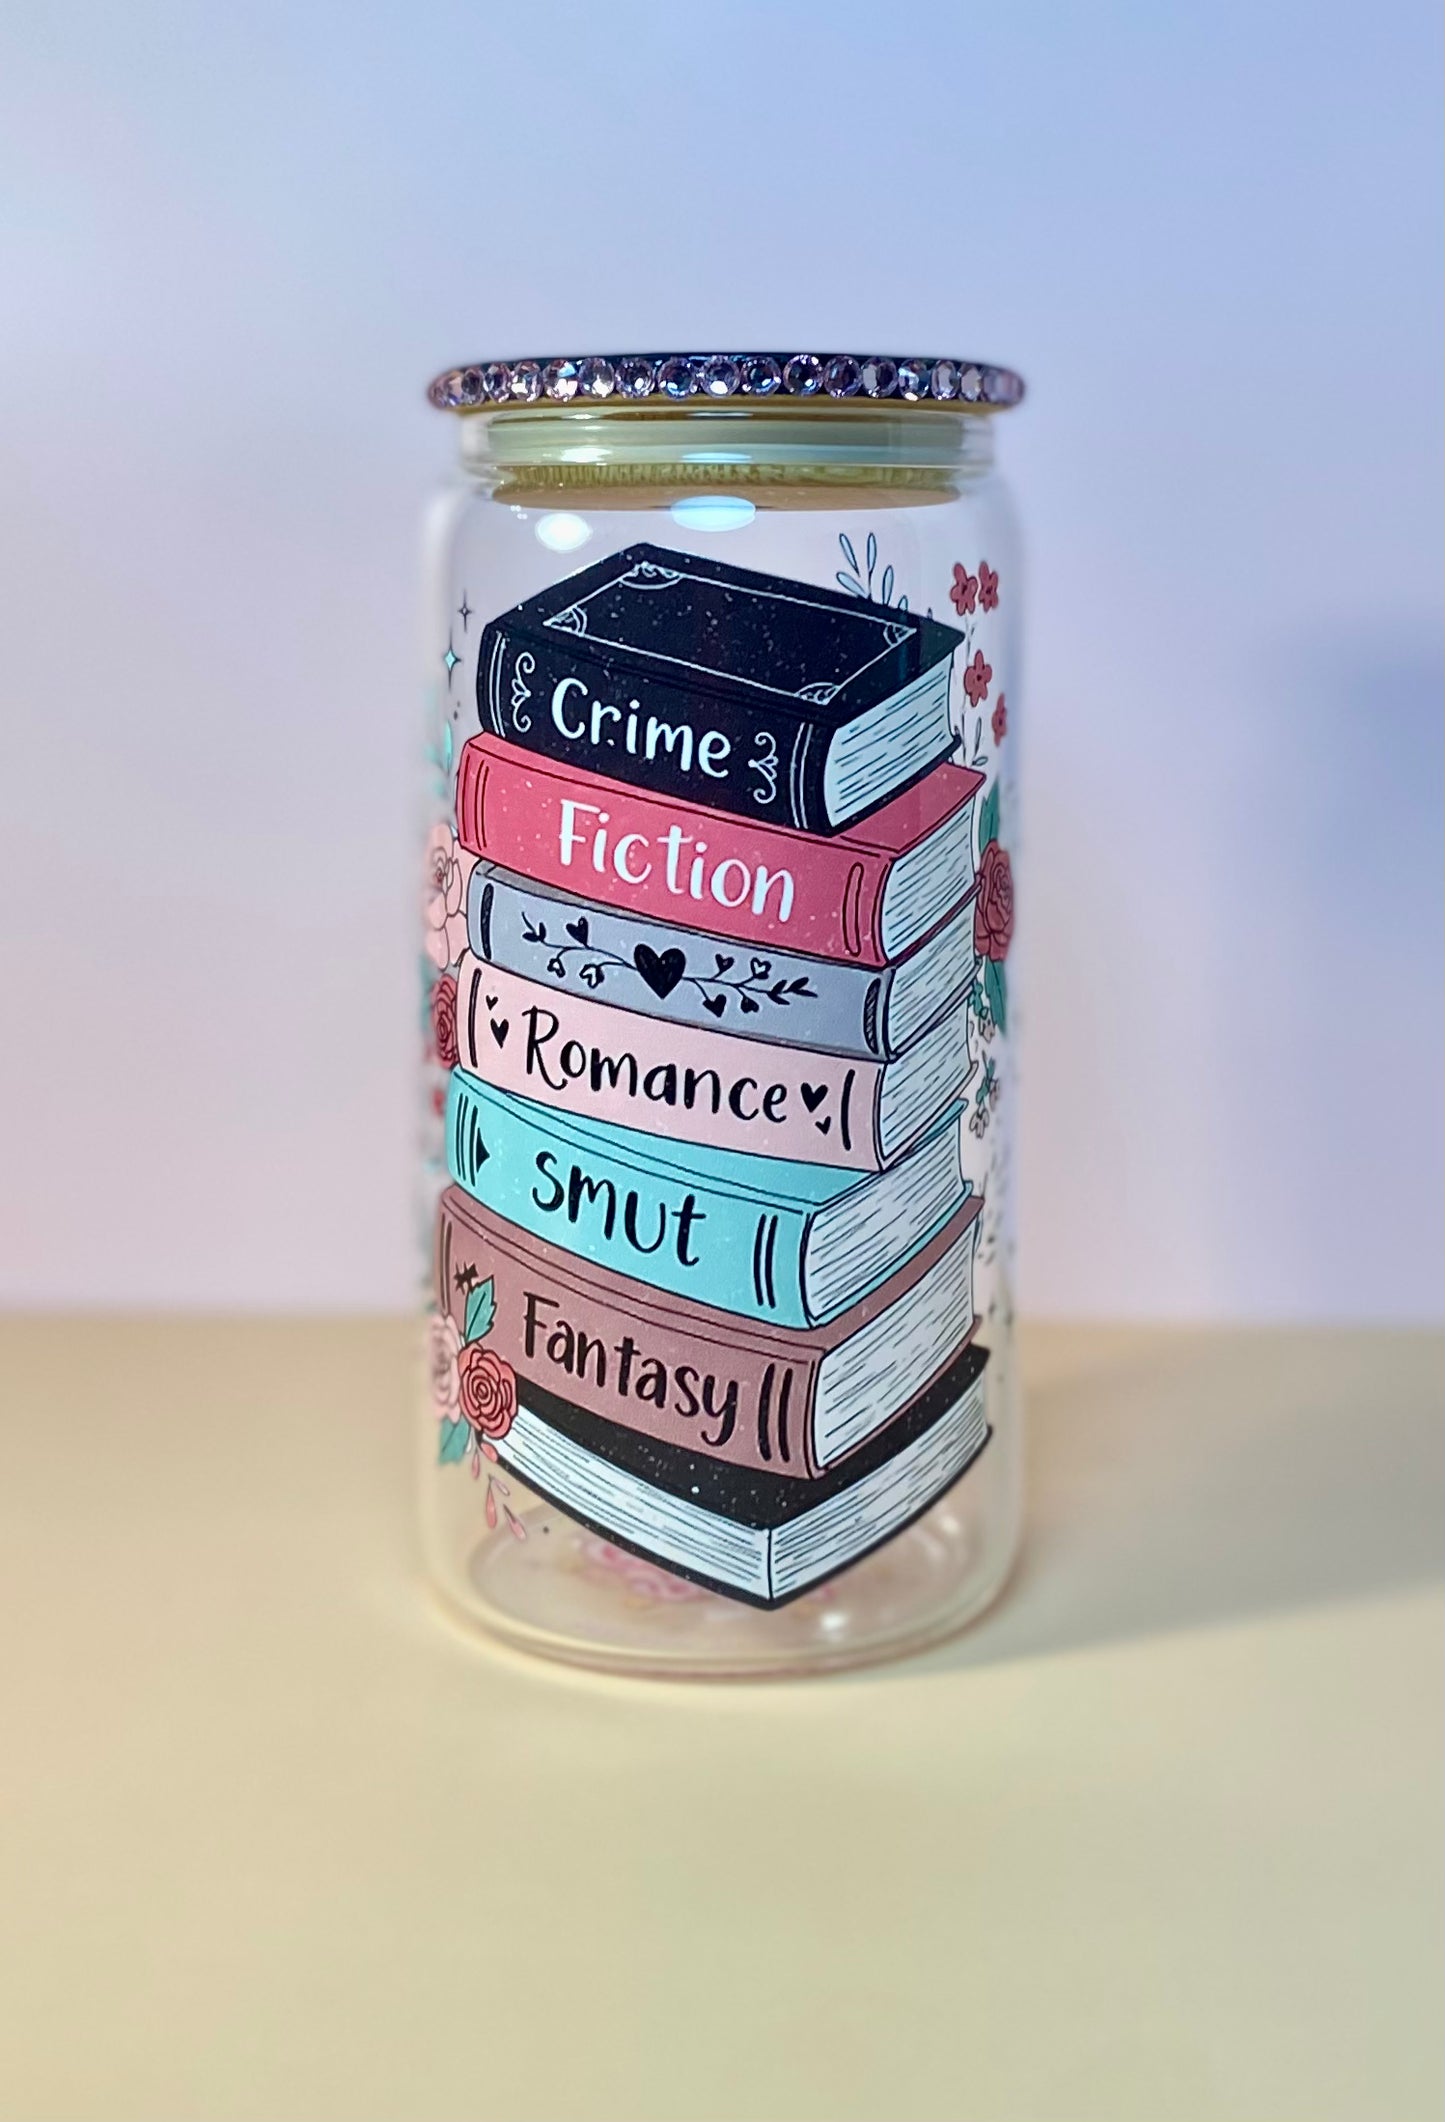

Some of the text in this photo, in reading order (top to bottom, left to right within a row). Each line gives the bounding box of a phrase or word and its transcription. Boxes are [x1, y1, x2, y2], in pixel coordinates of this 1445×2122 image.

[551, 678, 732, 778] Crime
[558, 798, 796, 922] Fiction
[522, 1006, 788, 1124] Romance
[522, 1291, 739, 1447] Fantasy
